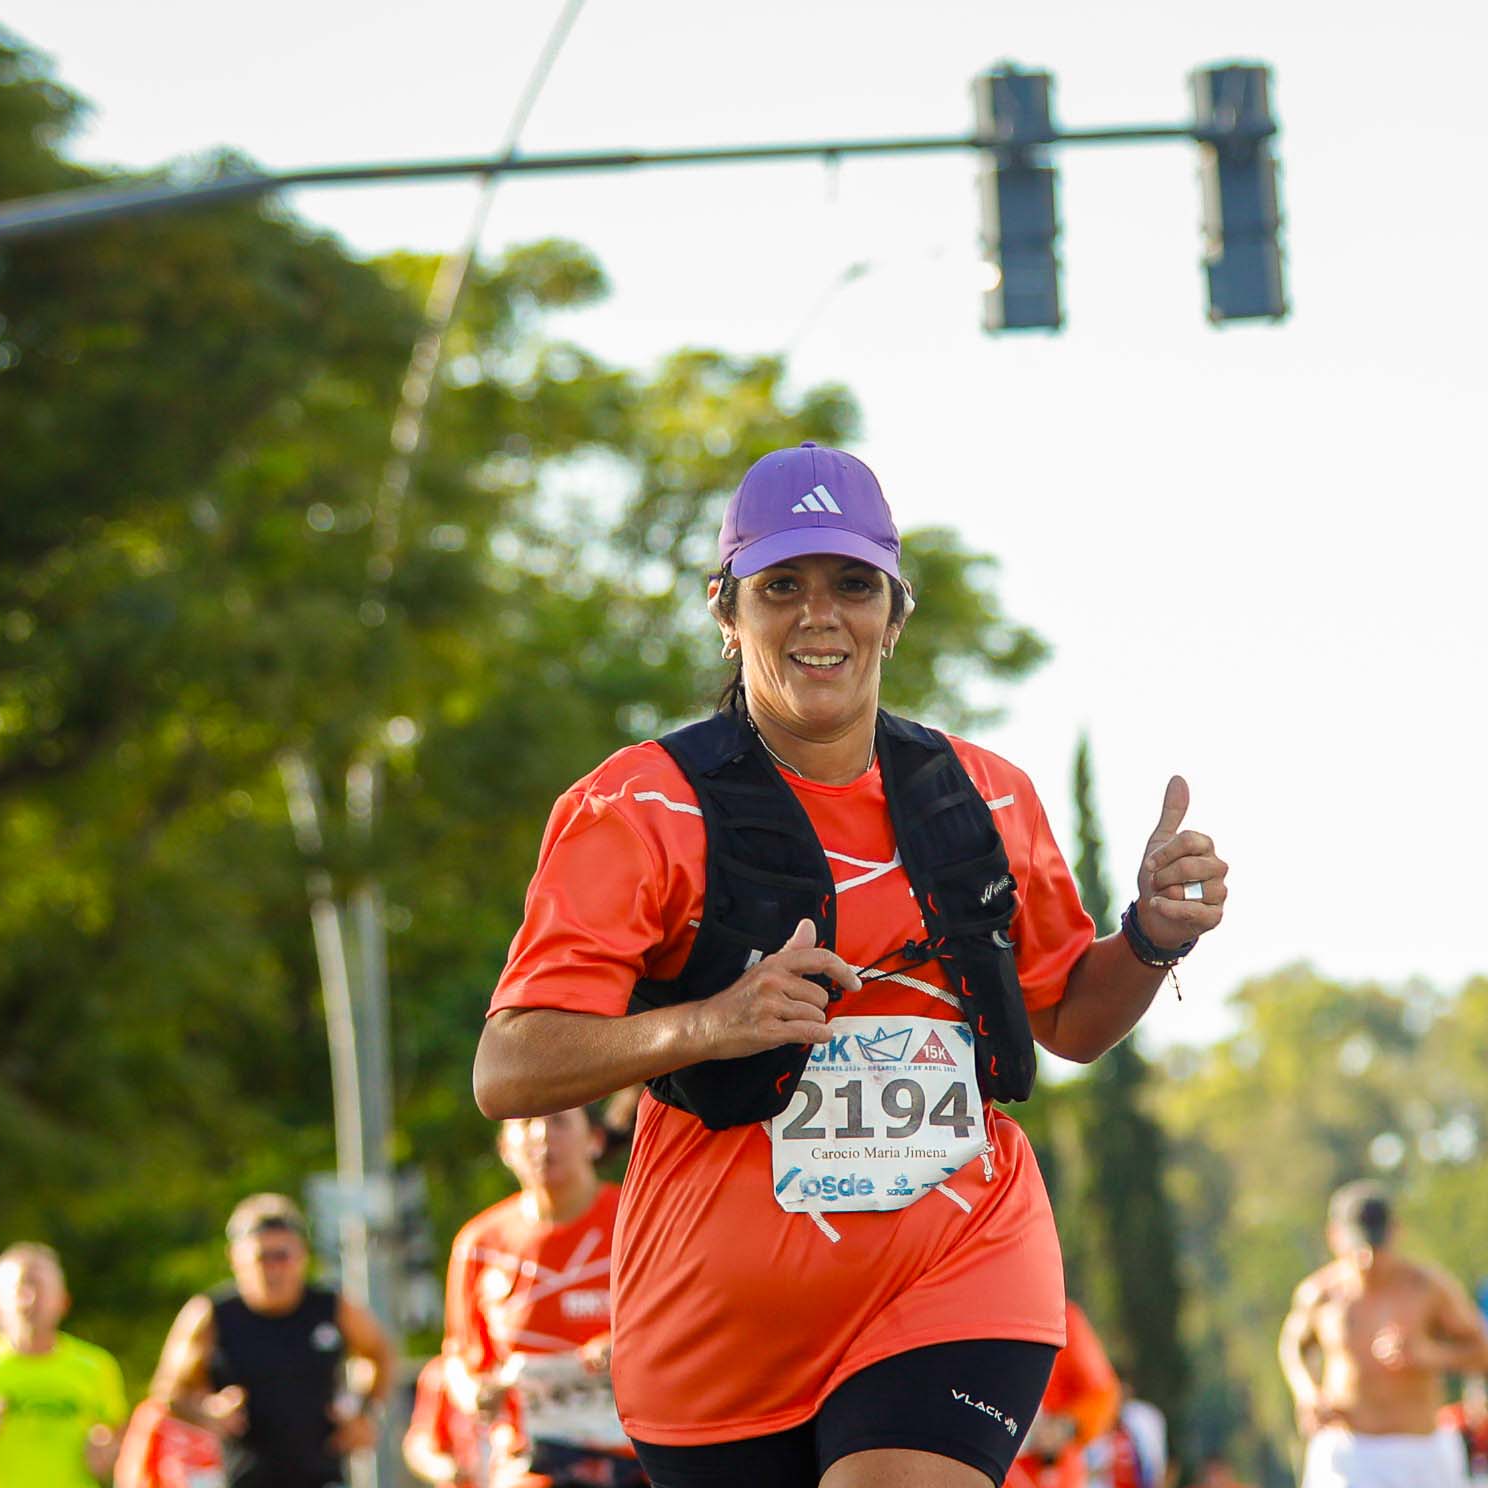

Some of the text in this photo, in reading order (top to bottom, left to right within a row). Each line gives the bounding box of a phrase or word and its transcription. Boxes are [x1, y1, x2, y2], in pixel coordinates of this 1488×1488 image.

[924, 1045, 947, 1060] 15K
[782, 1078, 976, 1140] 2194
[811, 1146, 948, 1160] Carocio Maria Jimena
[951, 1388, 1003, 1422] VLACK
